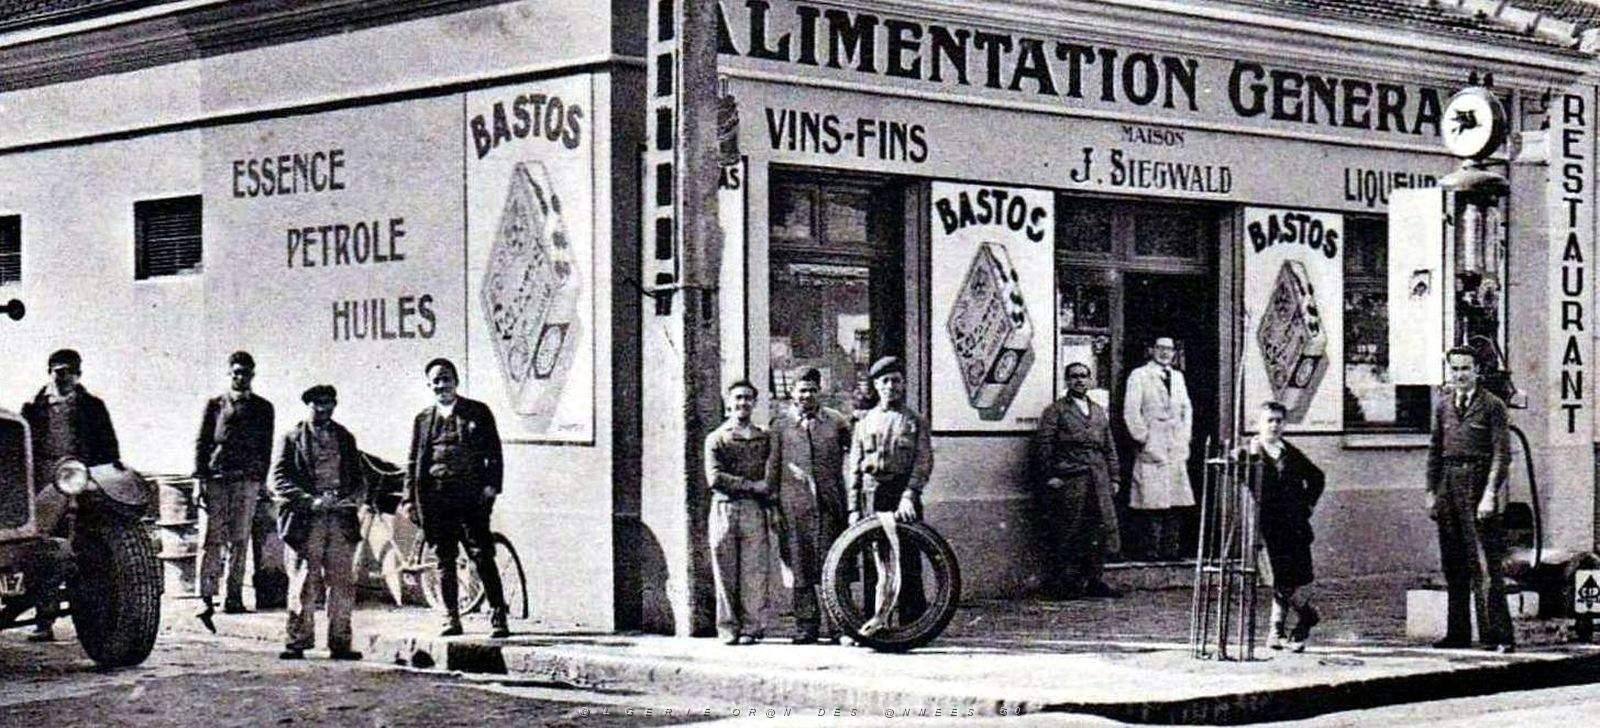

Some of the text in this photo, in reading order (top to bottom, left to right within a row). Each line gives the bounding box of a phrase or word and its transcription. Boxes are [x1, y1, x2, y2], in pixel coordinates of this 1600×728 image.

[1228, 60, 1443, 137] GENERA
[470, 93, 584, 159] BASTOS
[765, 107, 929, 164] VINS-FINS
[1121, 124, 1185, 147] MAISON
[232, 149, 346, 199] ESSENCE
[1070, 147, 1233, 195] J. SIEGWALD
[935, 188, 1047, 242] BASTOS
[1248, 212, 1338, 260] BASTOS
[286, 217, 406, 268] PETROLE
[1561, 94, 1585, 434] RESTAURANT
[332, 294, 437, 341] HUILES
